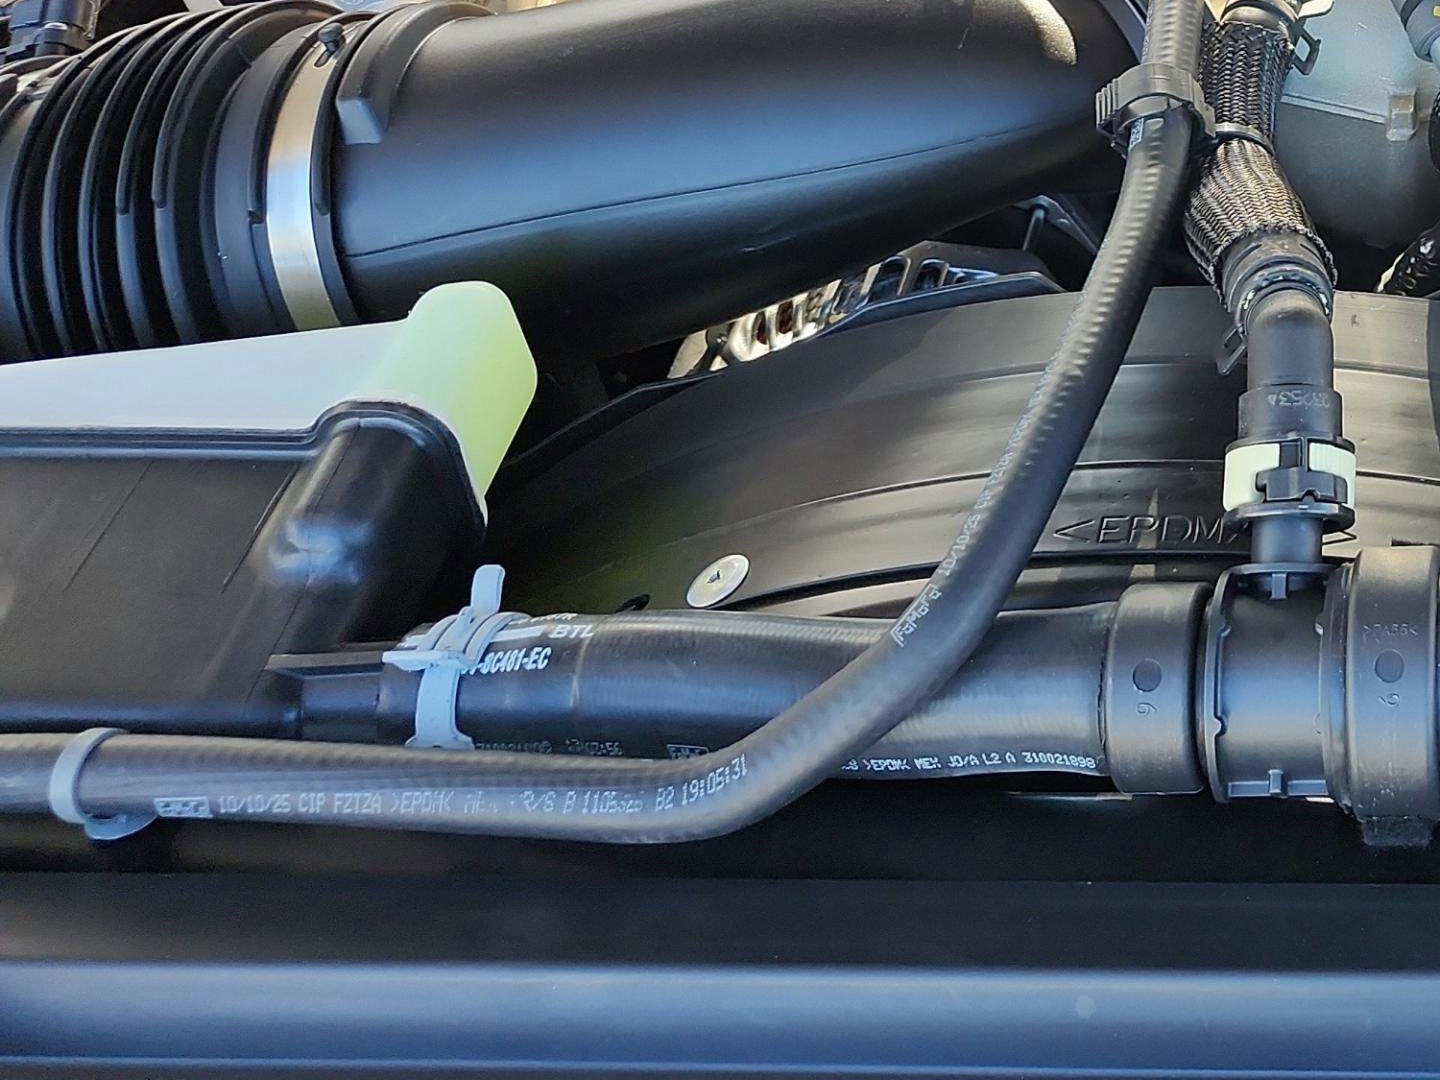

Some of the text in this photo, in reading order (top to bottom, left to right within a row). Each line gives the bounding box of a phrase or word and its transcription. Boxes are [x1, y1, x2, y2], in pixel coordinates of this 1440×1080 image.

[298, 793, 326, 814] CIP
[562, 791, 577, 814] B
[681, 753, 748, 805] 19:05:31
